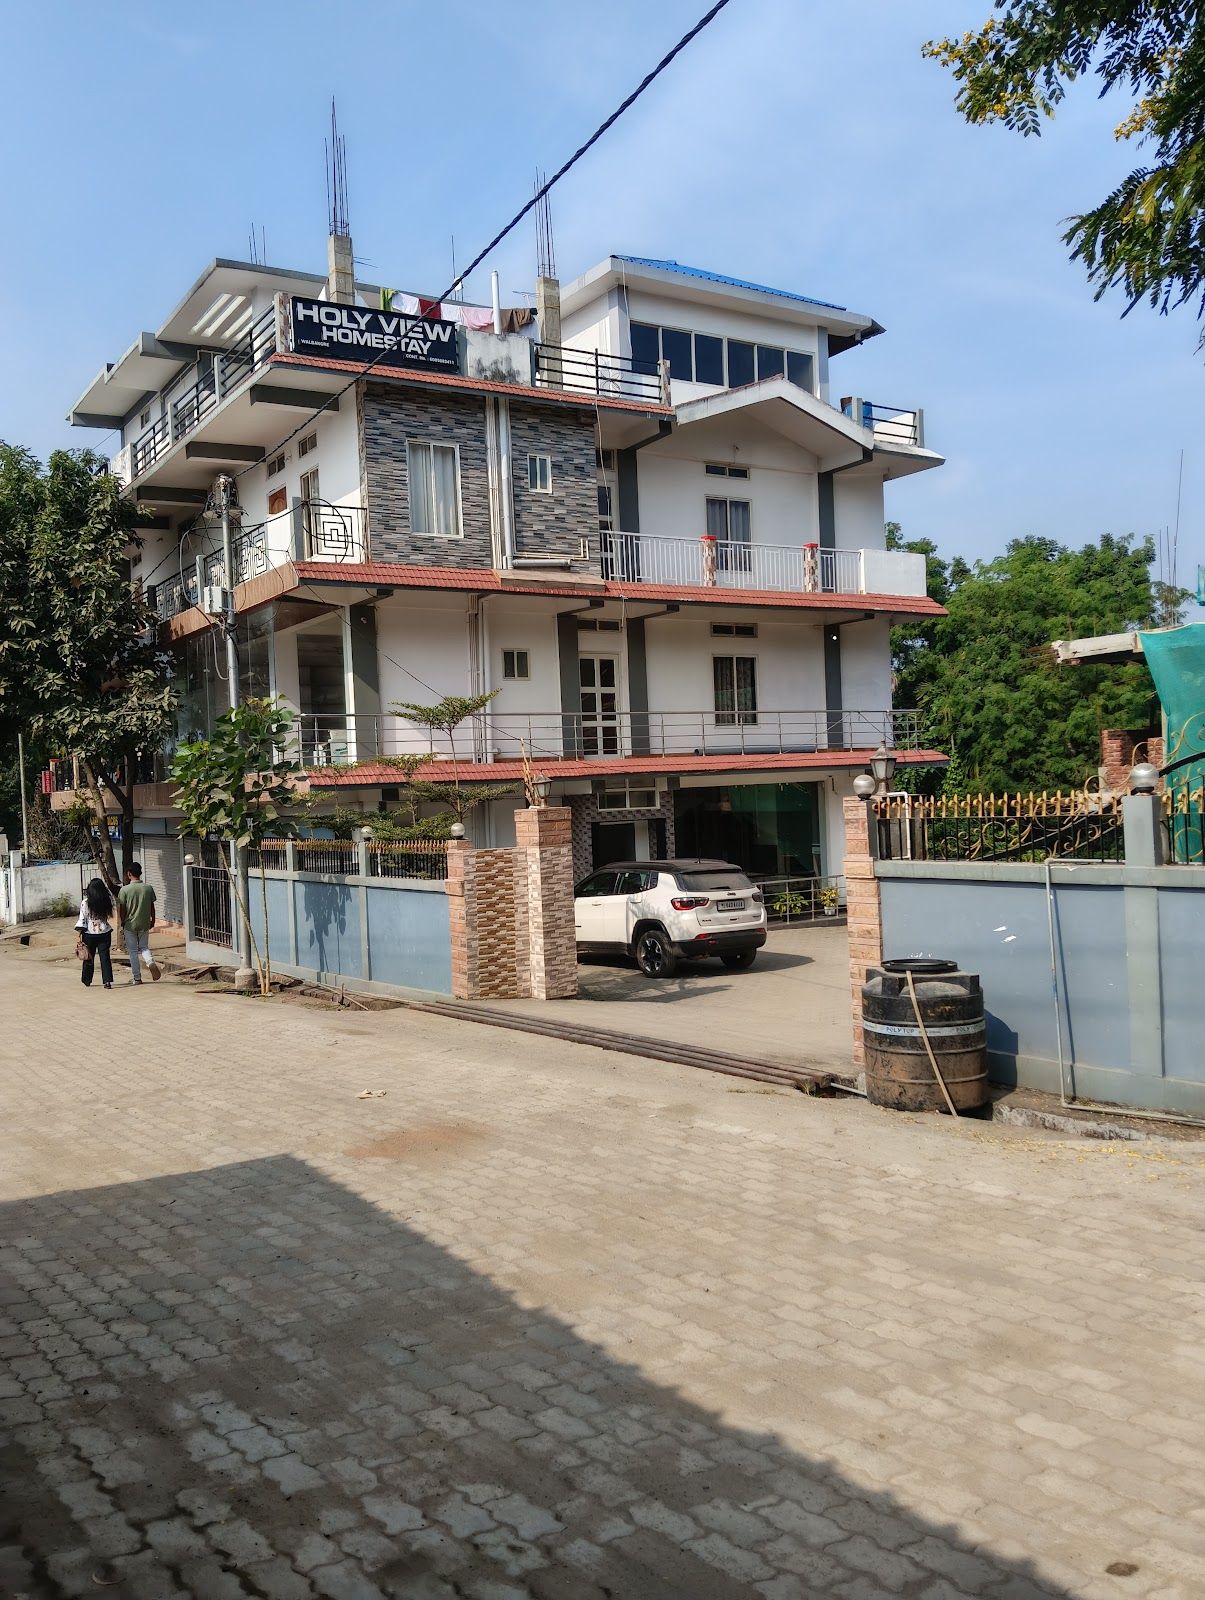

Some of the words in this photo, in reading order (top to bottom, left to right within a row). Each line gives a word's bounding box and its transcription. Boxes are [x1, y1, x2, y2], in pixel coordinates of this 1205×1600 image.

[297, 302, 373, 331] HOLY
[377, 314, 453, 343] VIEW
[322, 326, 432, 355] HOMESTAY
